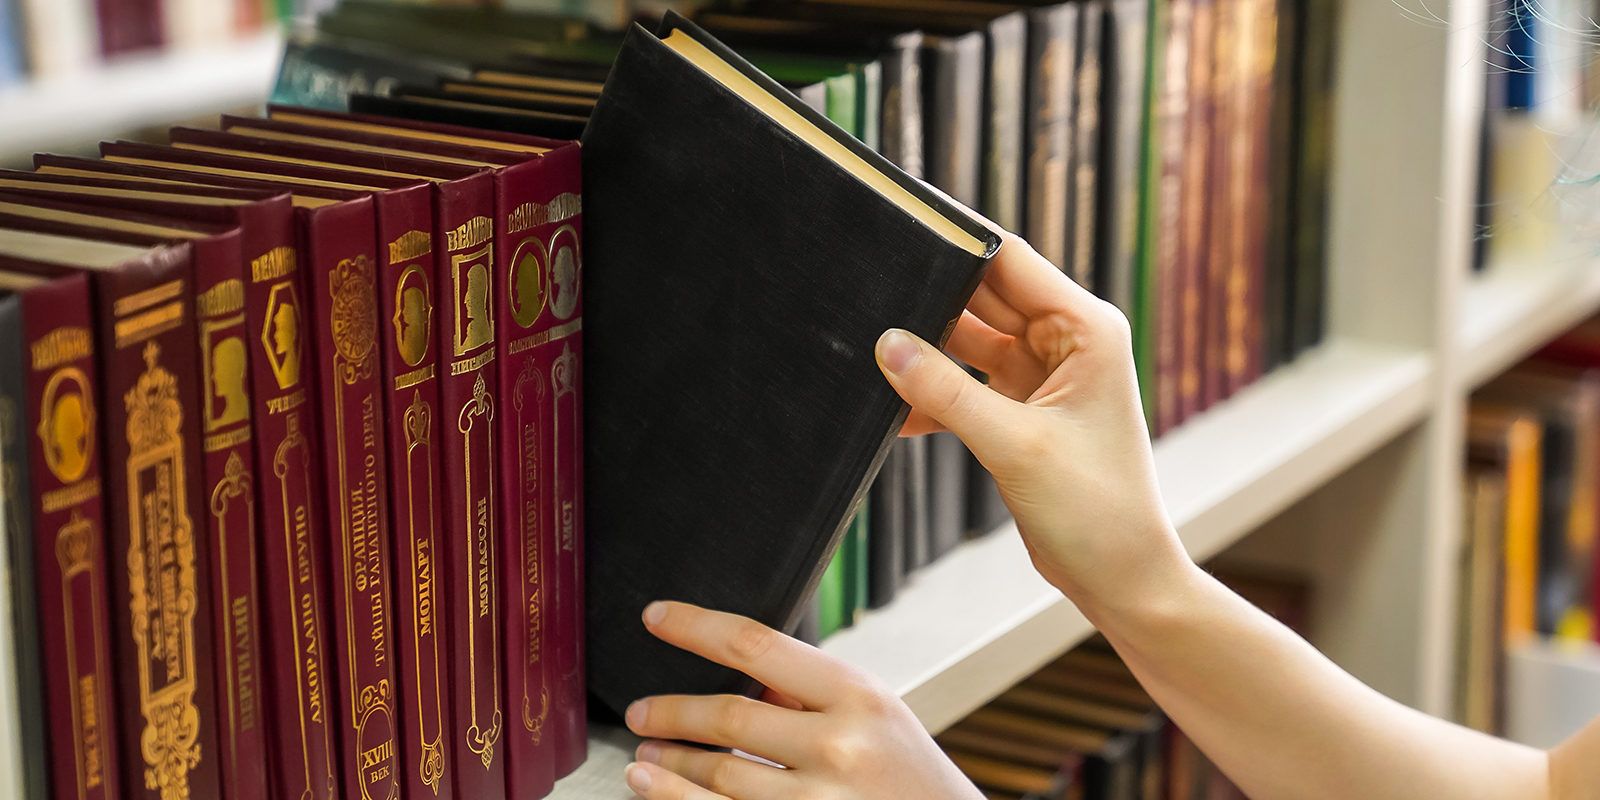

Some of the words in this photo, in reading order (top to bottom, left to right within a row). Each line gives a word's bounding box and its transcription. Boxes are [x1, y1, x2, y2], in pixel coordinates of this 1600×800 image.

[362, 393, 376, 448] ВЕКА
[525, 422, 537, 494] СЕРДЦЕ
[294, 505, 310, 583] БРУНО
[364, 454, 381, 588] ГАЛАНТНОГО
[477, 497, 489, 618] МОПАССАН
[526, 498, 538, 585] ЛЬВИНОЕ
[562, 500, 573, 552] ЛИСТ
[416, 538, 432, 637] МОЦАРТ
[301, 593, 322, 724] ДЖОРДАНО
[370, 592, 386, 667] ТАЙНЫ
[529, 589, 540, 664] РИЧАРД
[361, 738, 394, 770] XVIII
[371, 765, 390, 784] ВЕК
